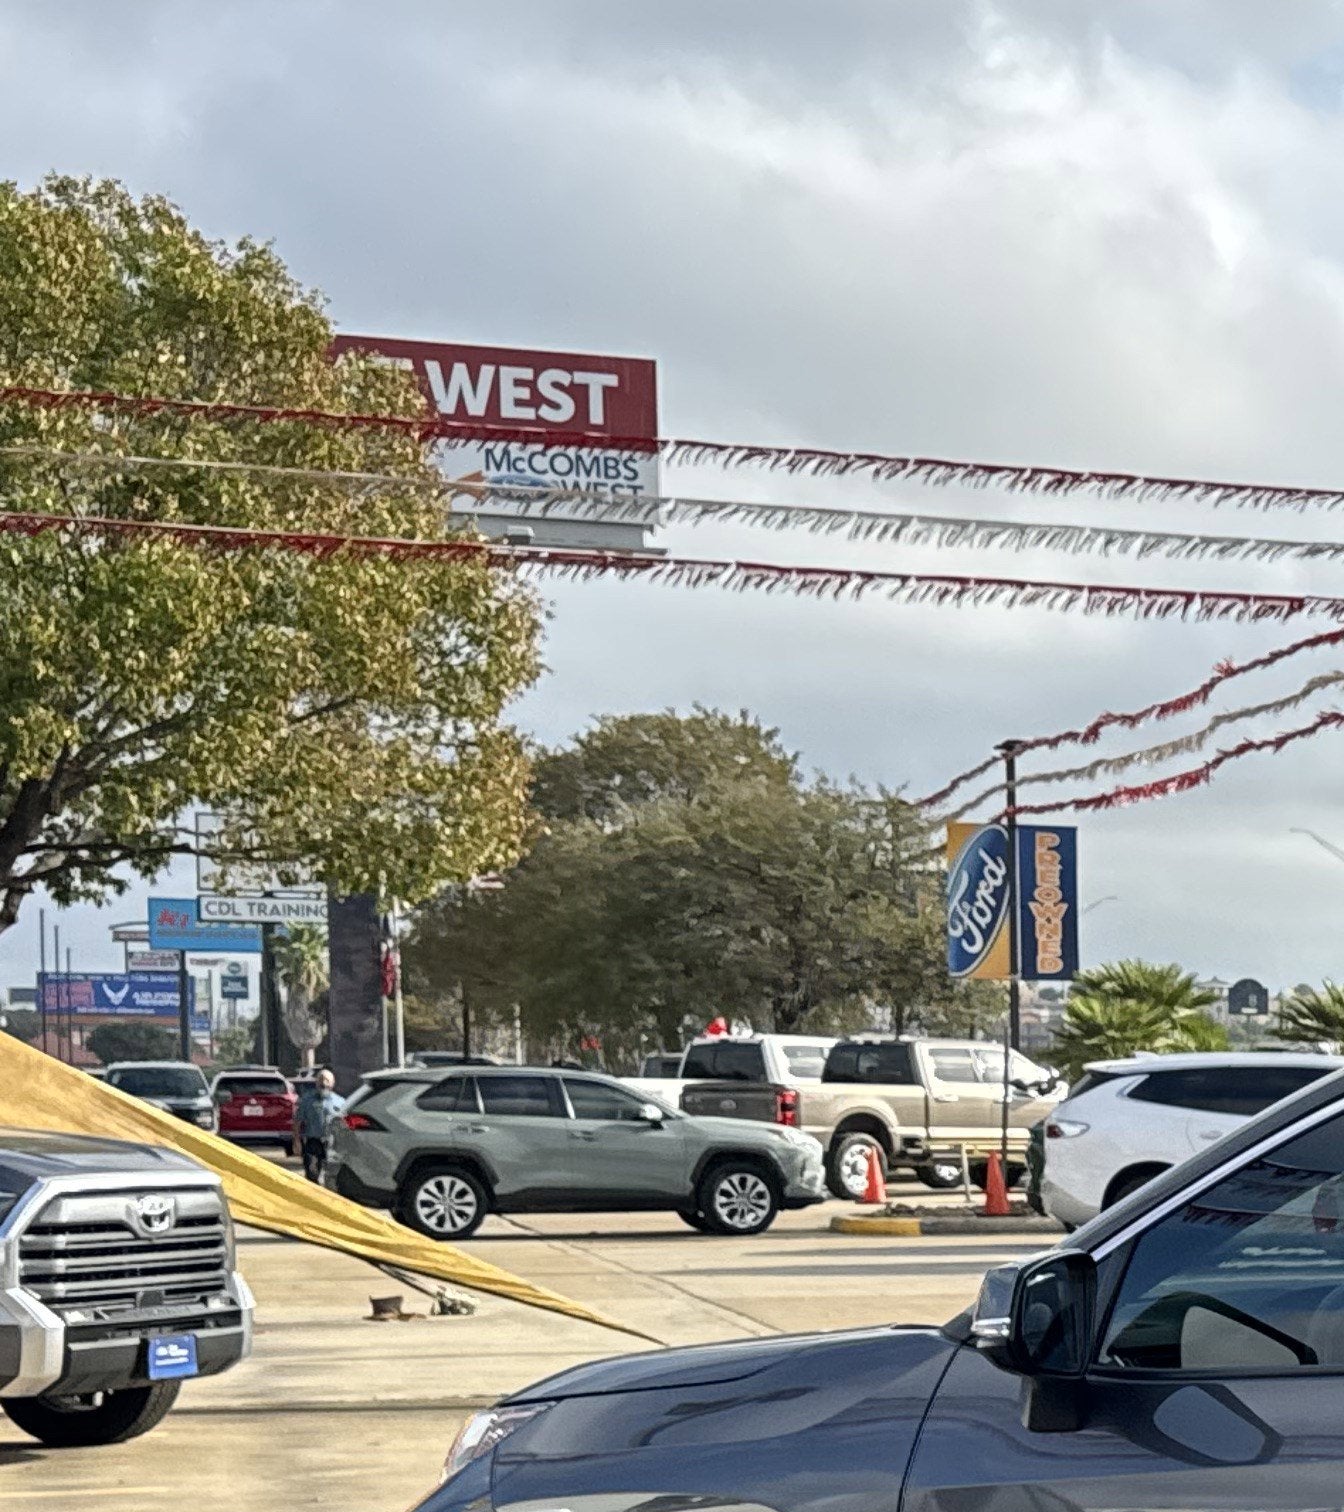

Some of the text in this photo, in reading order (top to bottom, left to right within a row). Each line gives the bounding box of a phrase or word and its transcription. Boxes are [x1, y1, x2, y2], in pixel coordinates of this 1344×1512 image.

[424, 359, 619, 427] WEST
[484, 447, 640, 482] McCOMBS
[204, 901, 242, 917] CDL
[948, 847, 1008, 955] Ford
[1028, 831, 1069, 974] PREOWNED
